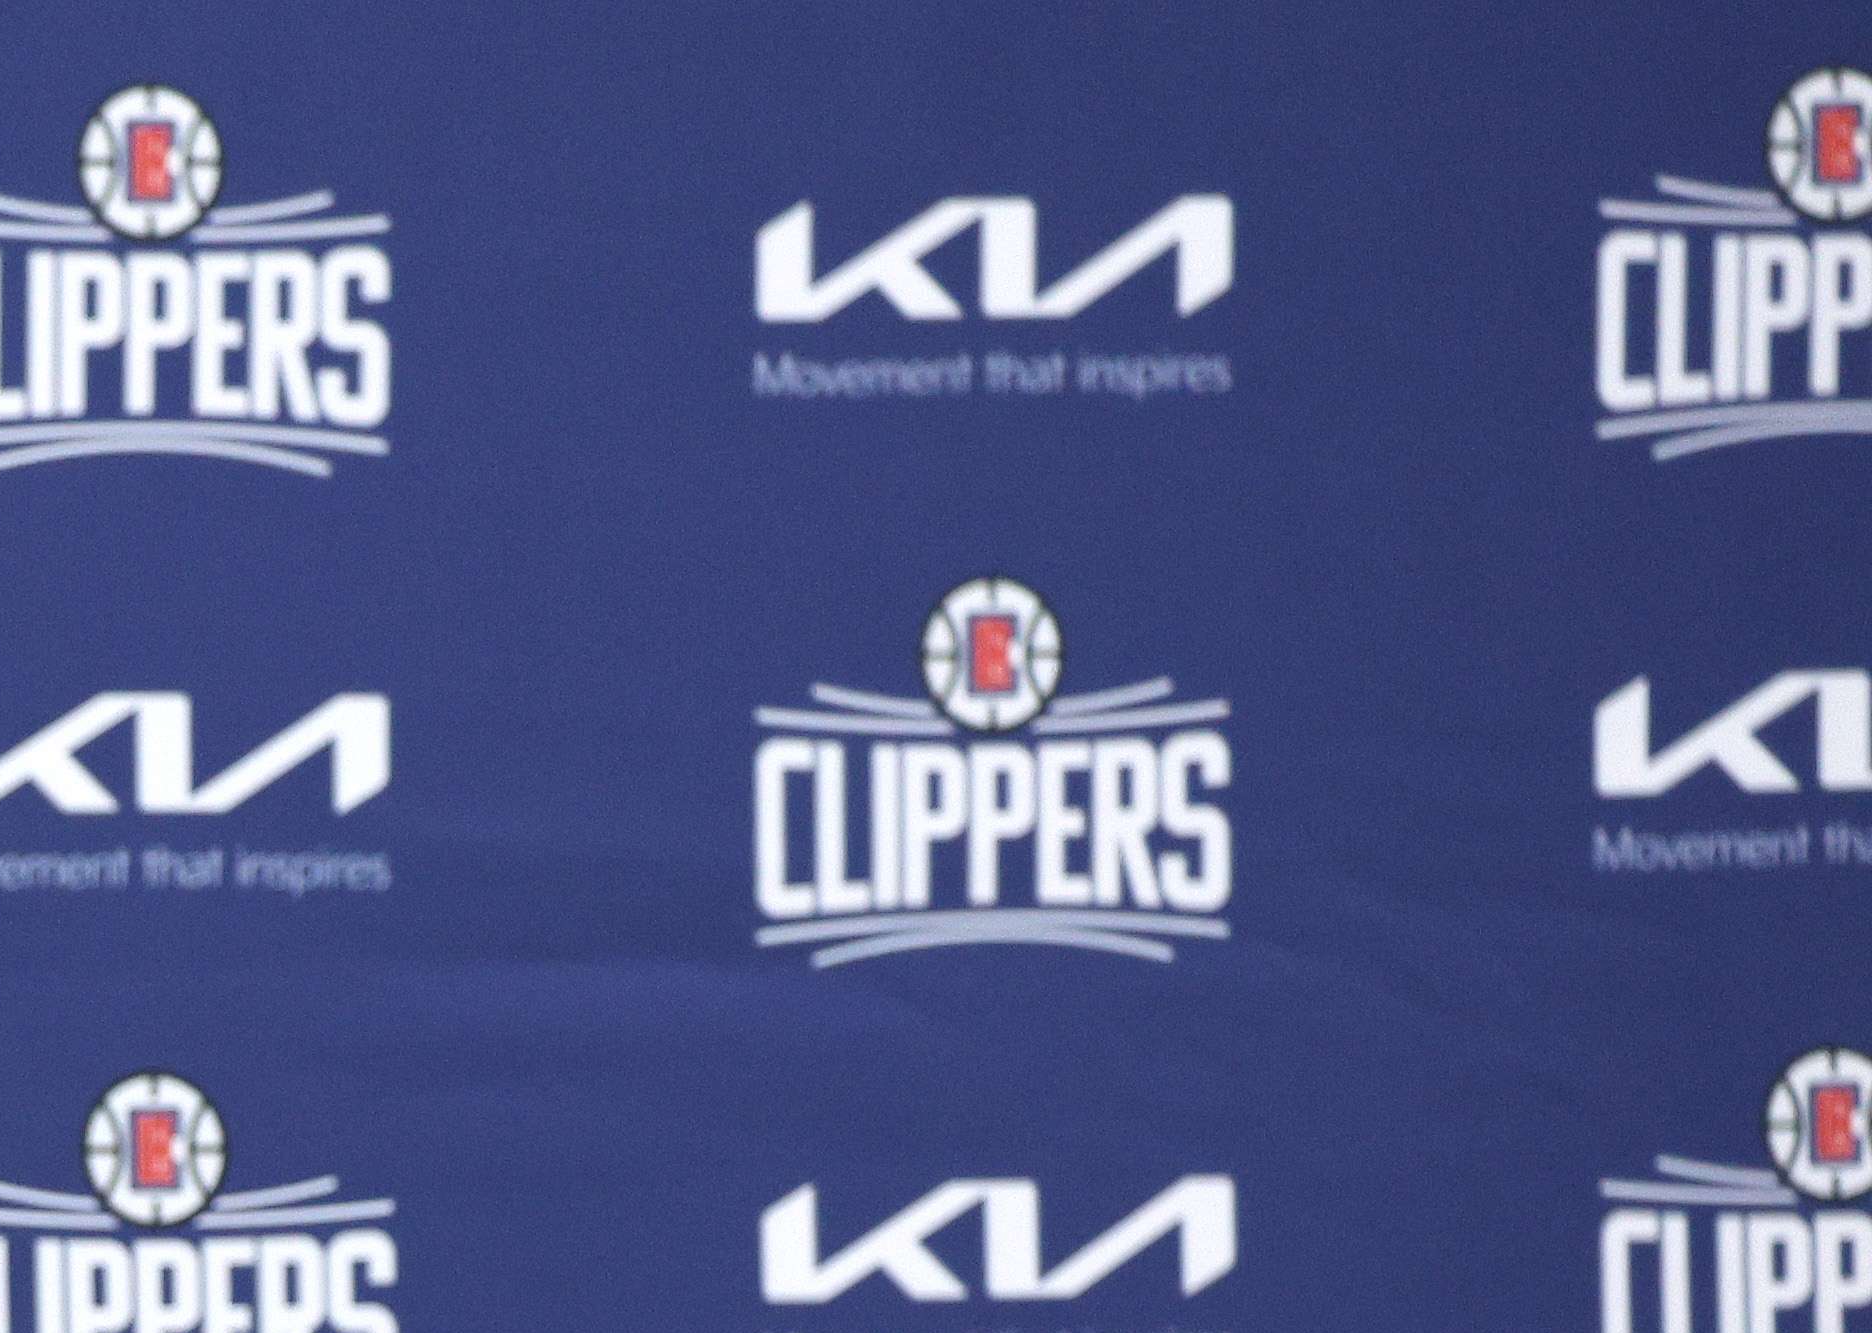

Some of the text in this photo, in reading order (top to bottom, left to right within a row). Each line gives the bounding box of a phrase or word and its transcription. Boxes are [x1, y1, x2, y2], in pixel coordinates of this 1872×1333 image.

[755, 195, 1234, 323] KIA
[1596, 230, 1872, 413] CLIPP
[752, 350, 1232, 400] Movement that inspires
[1593, 669, 1872, 798] KI
[140, 845, 224, 889] that
[234, 846, 392, 897] inspires
[754, 733, 1232, 917] CLIPPERS
[1592, 823, 1810, 871] Movement
[759, 1174, 1237, 1304] KIA
